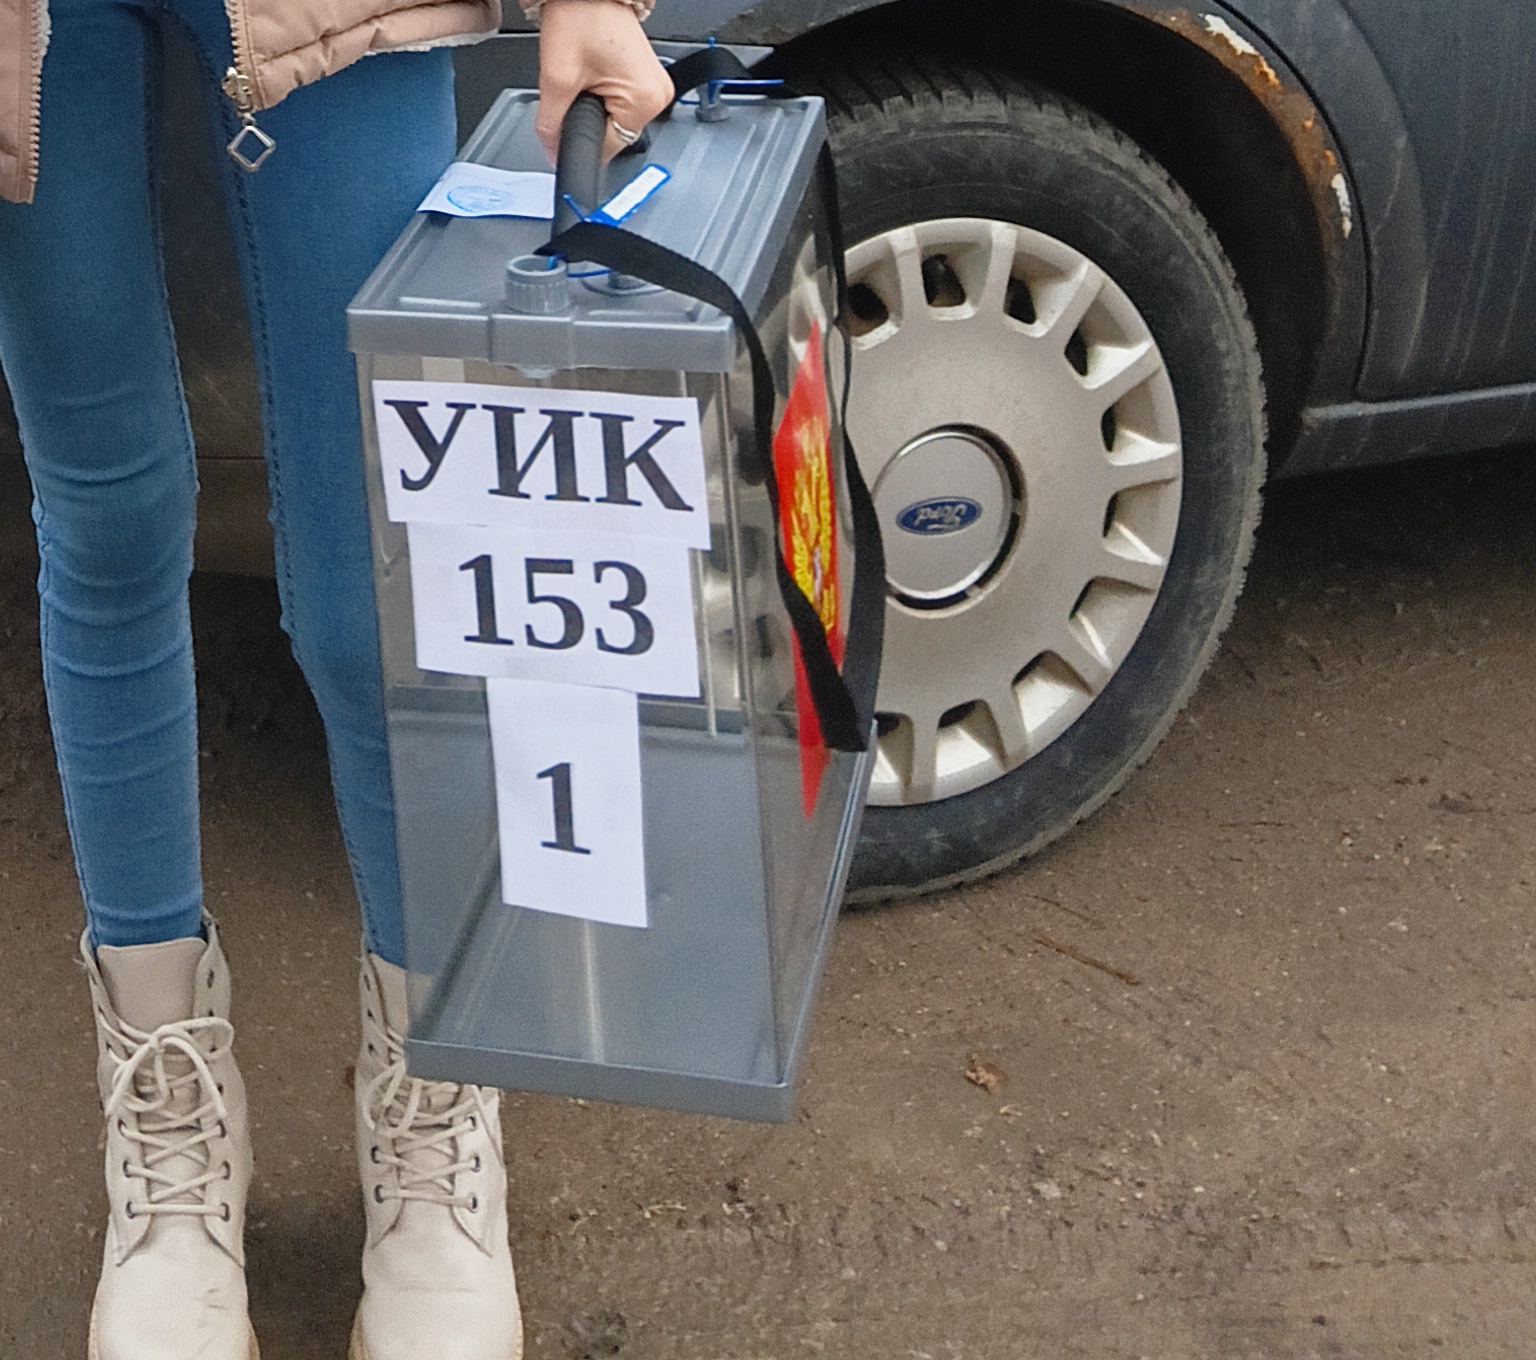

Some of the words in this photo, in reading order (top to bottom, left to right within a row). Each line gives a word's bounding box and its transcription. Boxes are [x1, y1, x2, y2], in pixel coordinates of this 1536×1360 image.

[383, 398, 695, 512] УИК
[457, 553, 655, 656] 153
[535, 761, 592, 855] 1
